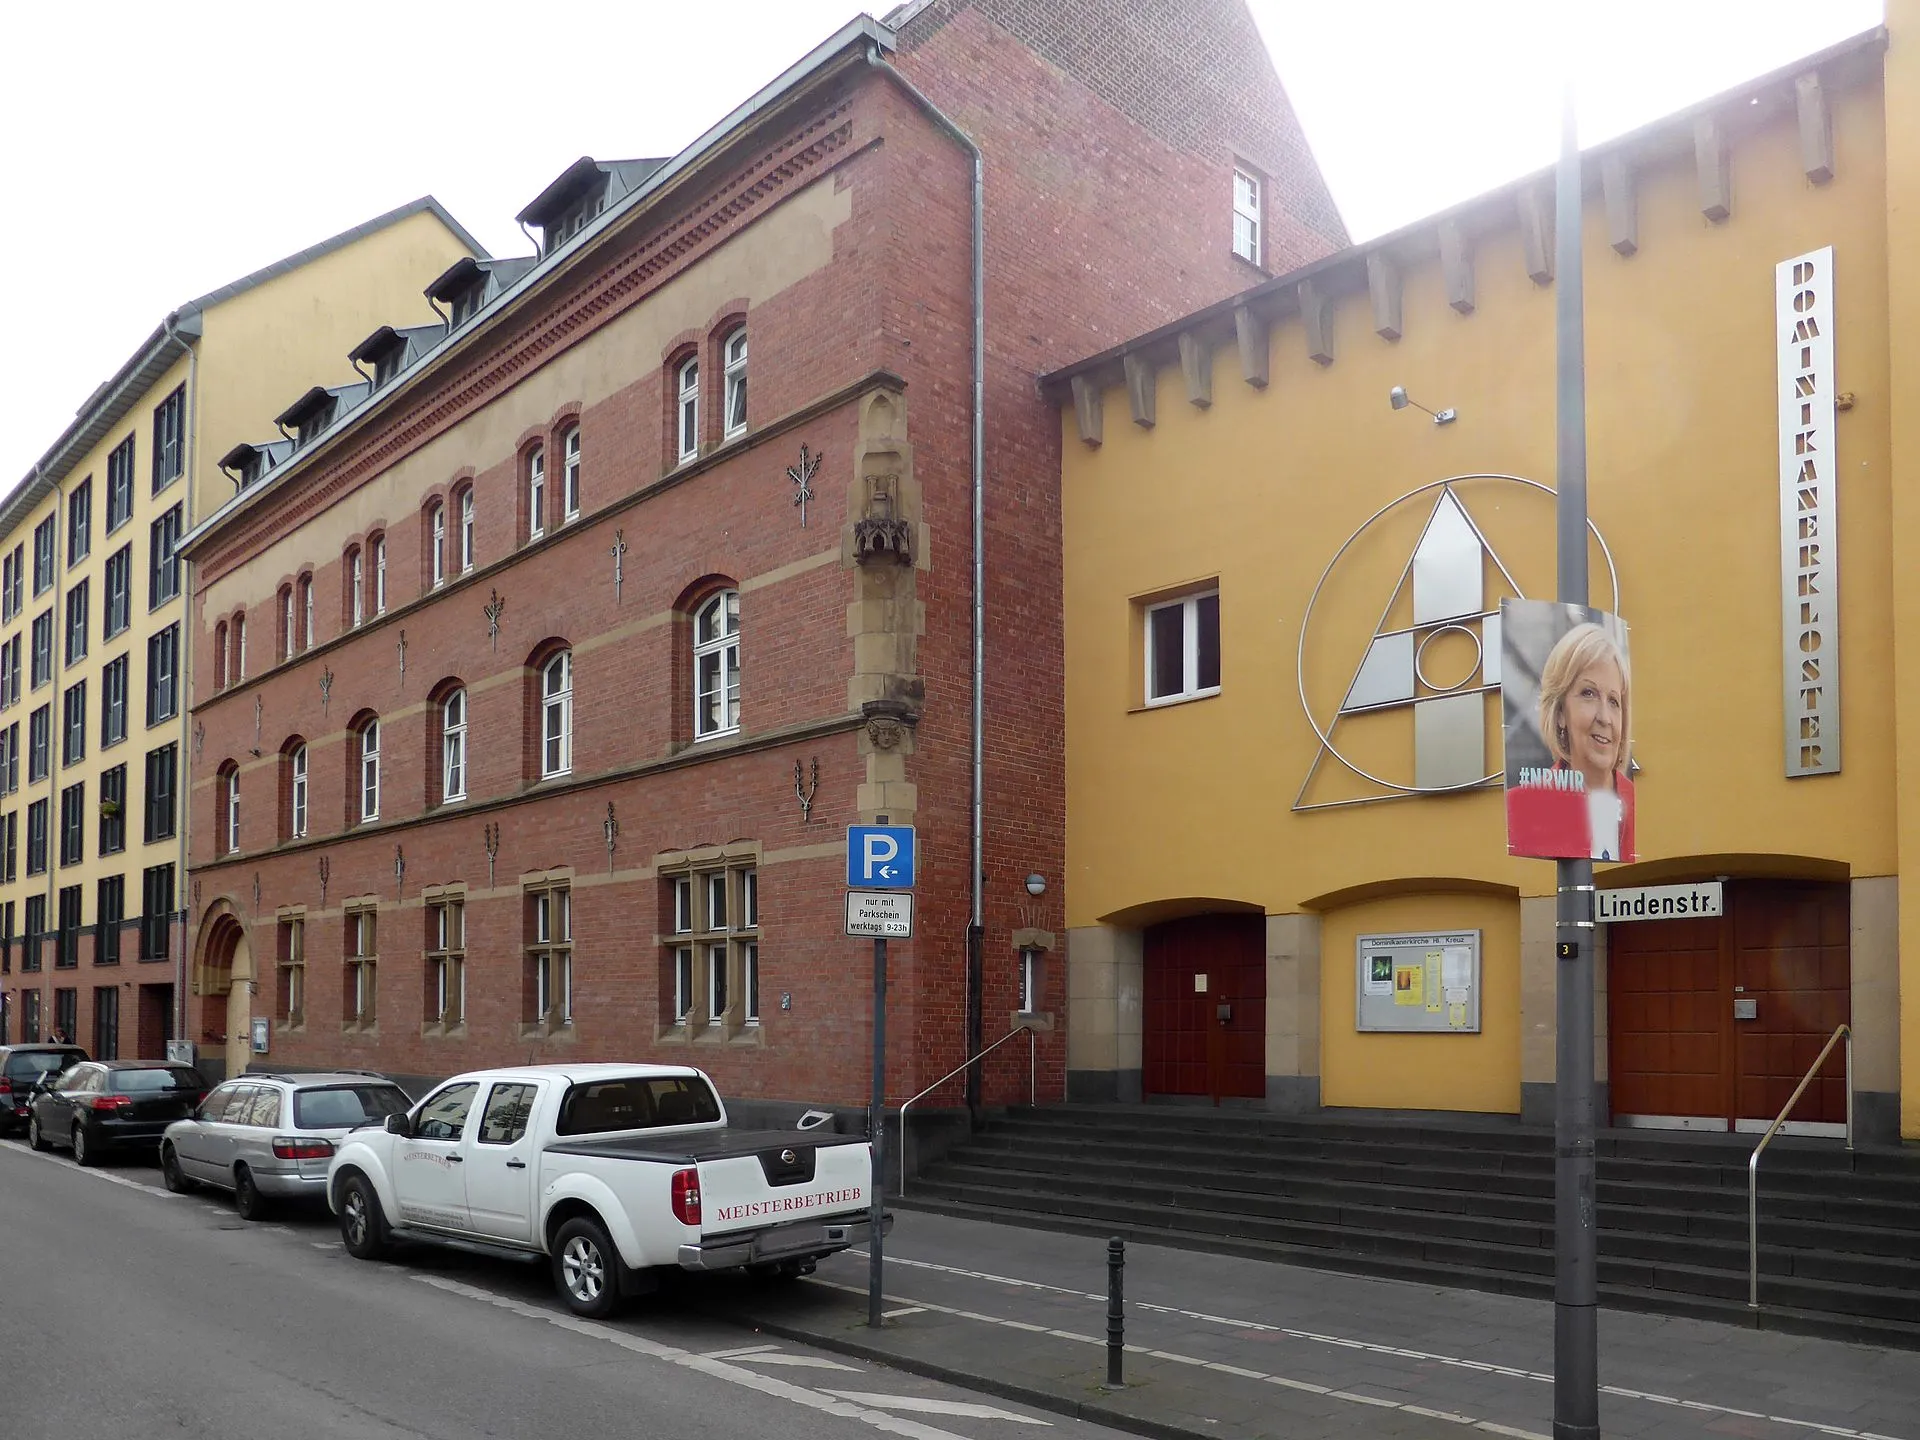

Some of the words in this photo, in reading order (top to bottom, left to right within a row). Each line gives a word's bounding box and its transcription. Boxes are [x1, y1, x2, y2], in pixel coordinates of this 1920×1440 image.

[1790, 260, 1824, 769] DOMINIKANERKLOSTER
[1518, 767, 1585, 793] #NRWIR
[863, 834, 899, 879] P
[865, 898, 878, 906] nur
[881, 898, 894, 906] mit
[1599, 891, 1716, 917] Lindenstr.
[859, 909, 900, 920] Parkschein
[850, 922, 882, 933] werktags
[1371, 938, 1430, 947] Dominikanerkirche
[1562, 945, 1569, 955] 3
[717, 1187, 862, 1221] MEISTERBETRIEB
